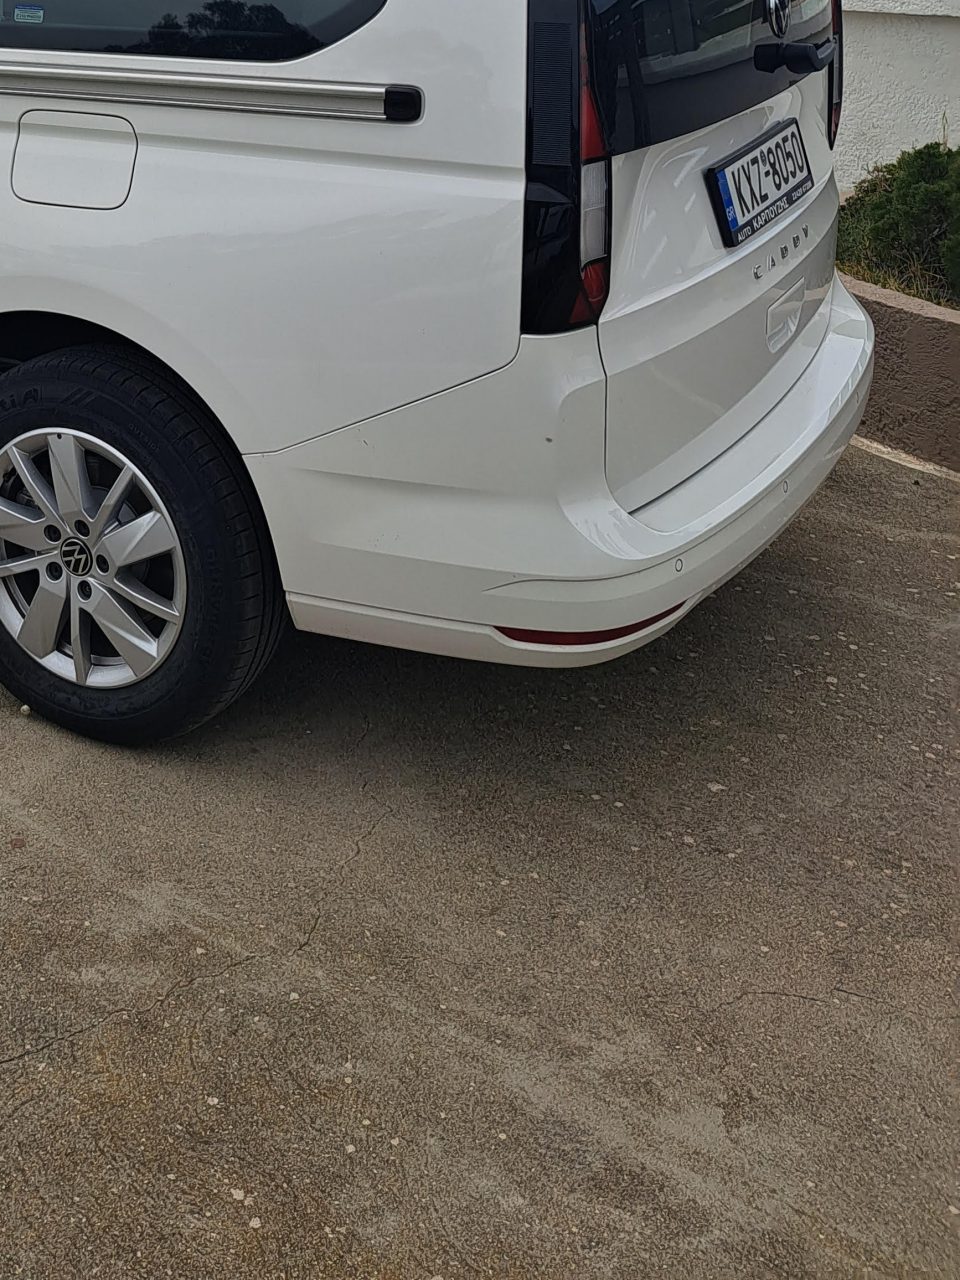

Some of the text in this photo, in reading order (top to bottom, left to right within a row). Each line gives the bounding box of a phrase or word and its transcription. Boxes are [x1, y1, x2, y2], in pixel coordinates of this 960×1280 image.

[726, 207, 737, 221] GR
[737, 226, 752, 242] AUTO
[752, 224, 809, 280] CADDY
